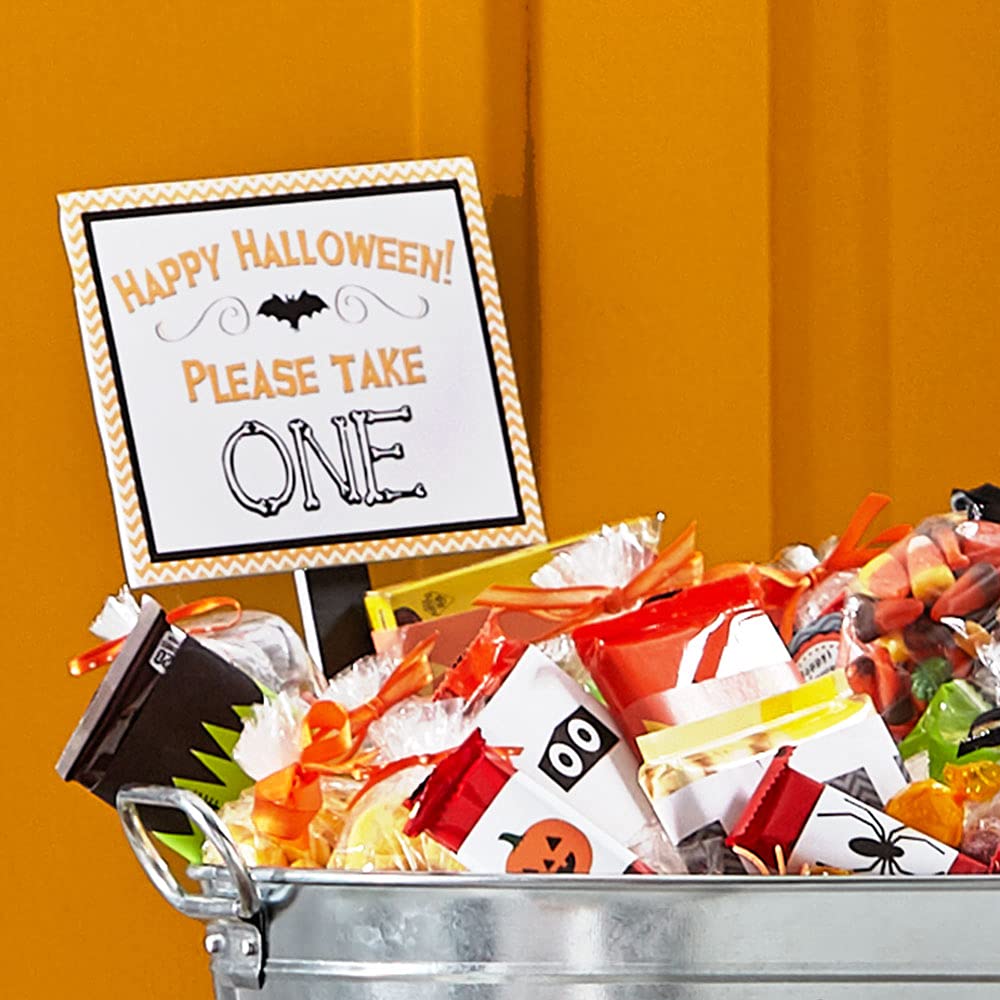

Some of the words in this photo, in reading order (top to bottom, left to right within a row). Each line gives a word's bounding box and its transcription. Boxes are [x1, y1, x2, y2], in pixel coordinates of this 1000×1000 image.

[111, 243, 220, 314] HAPPY
[231, 229, 455, 285] HALLOWEEN!
[181, 355, 320, 404] PLEASE
[329, 345, 427, 394] TAKE
[221, 404, 428, 517] ONE
